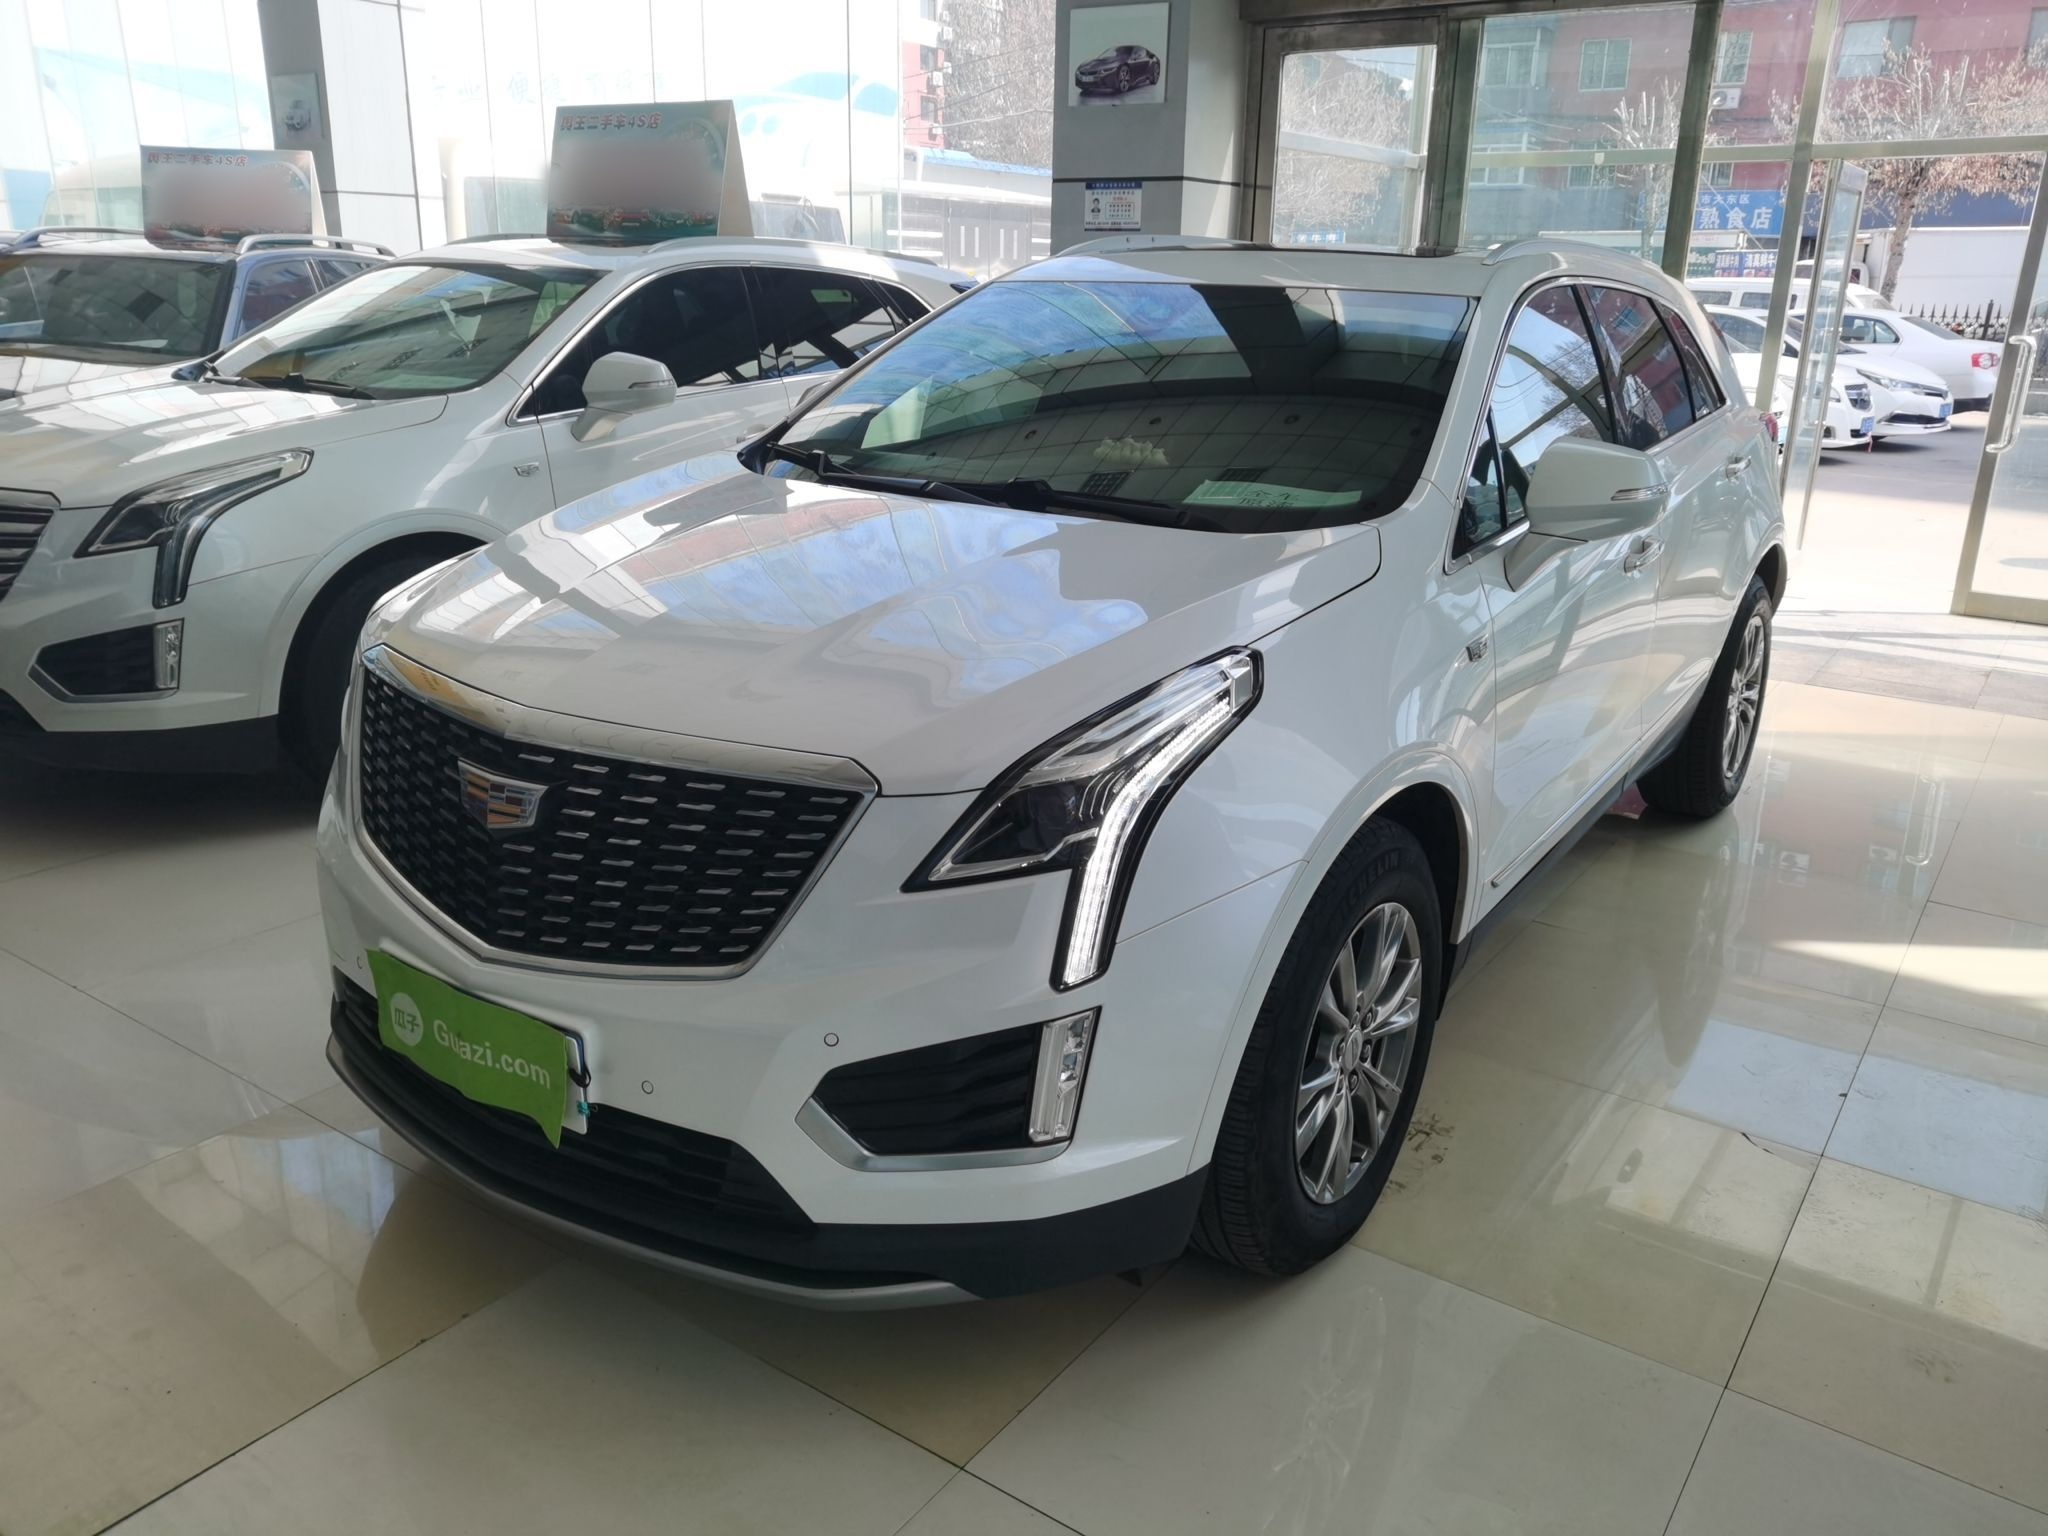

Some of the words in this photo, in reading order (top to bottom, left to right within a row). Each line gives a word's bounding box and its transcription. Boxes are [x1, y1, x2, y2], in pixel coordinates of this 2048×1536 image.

[1701, 194, 1750, 204] 市大东区
[1700, 207, 1773, 229] 熟食店
[1744, 252, 1778, 268] 清真鲜牛
[393, 1007, 421, 1034] 瓜子
[432, 1019, 551, 1090] Guazi.com
